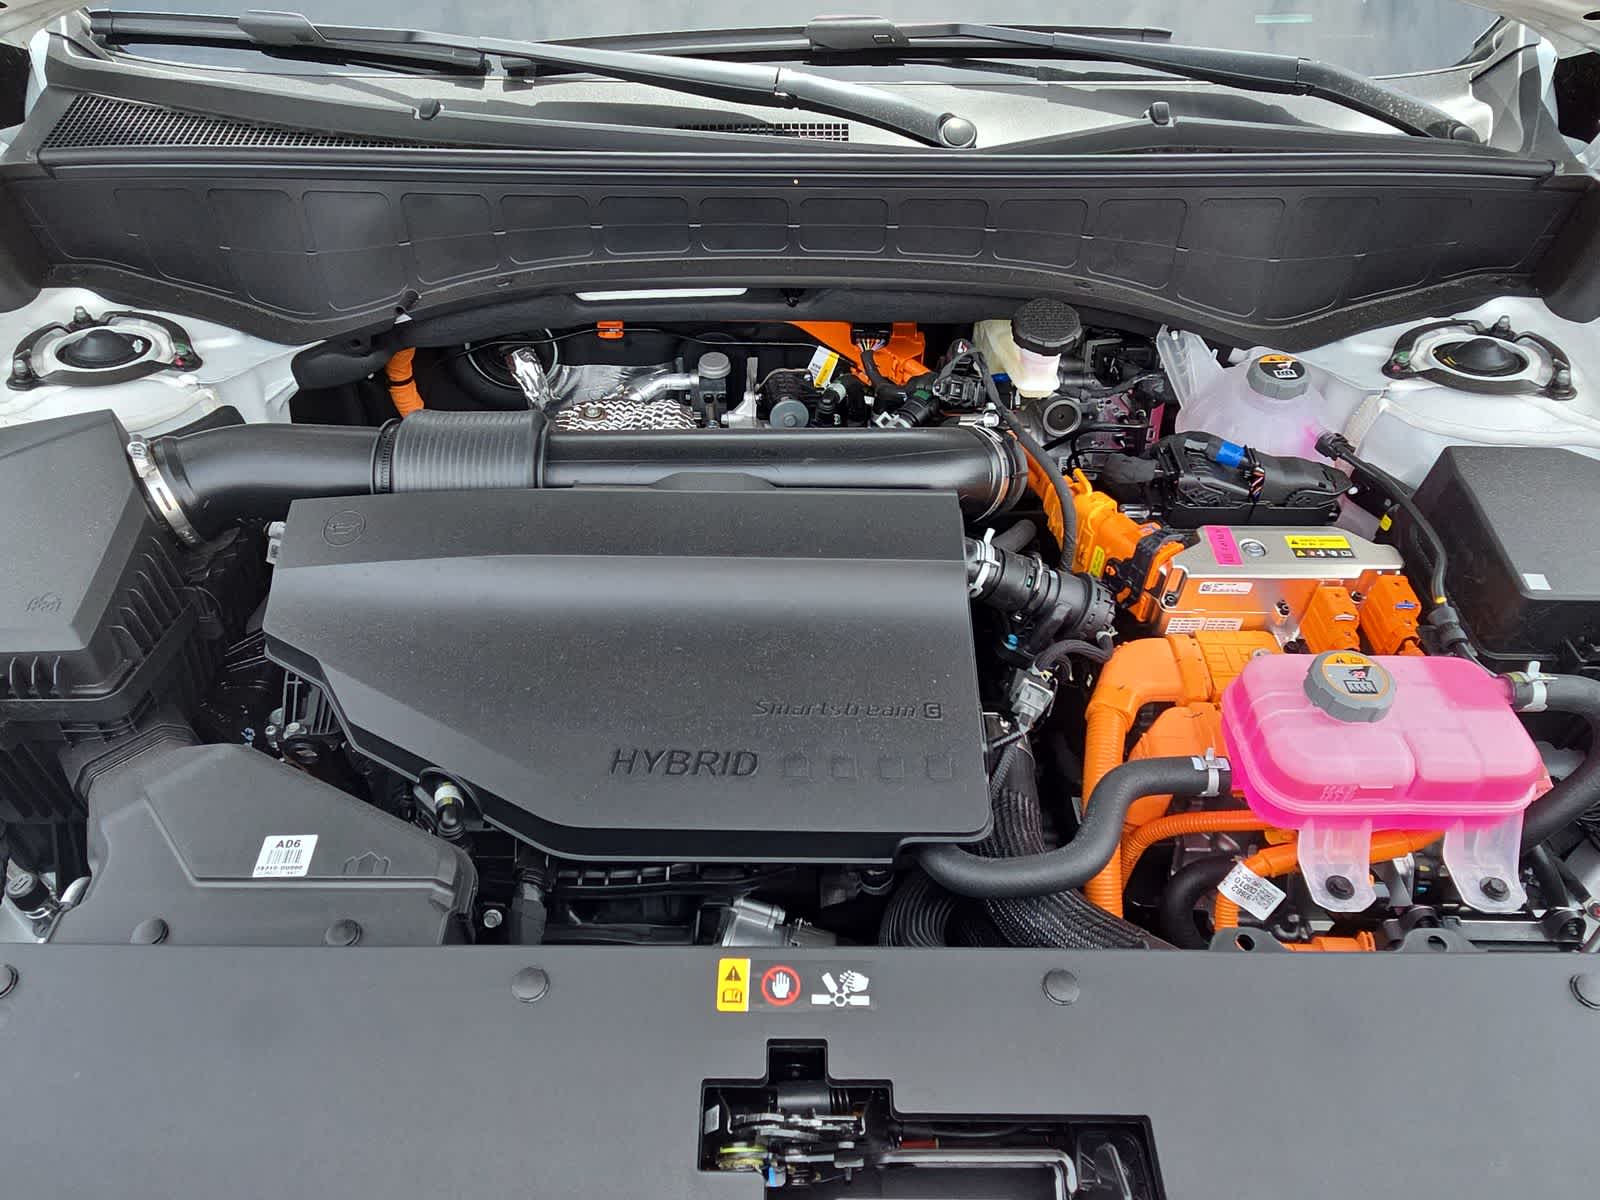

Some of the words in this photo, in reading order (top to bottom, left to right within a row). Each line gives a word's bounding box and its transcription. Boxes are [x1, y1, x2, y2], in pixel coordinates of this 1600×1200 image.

[752, 700, 916, 719] Smartstream
[922, 702, 943, 720] G
[609, 749, 761, 778] HYBRID
